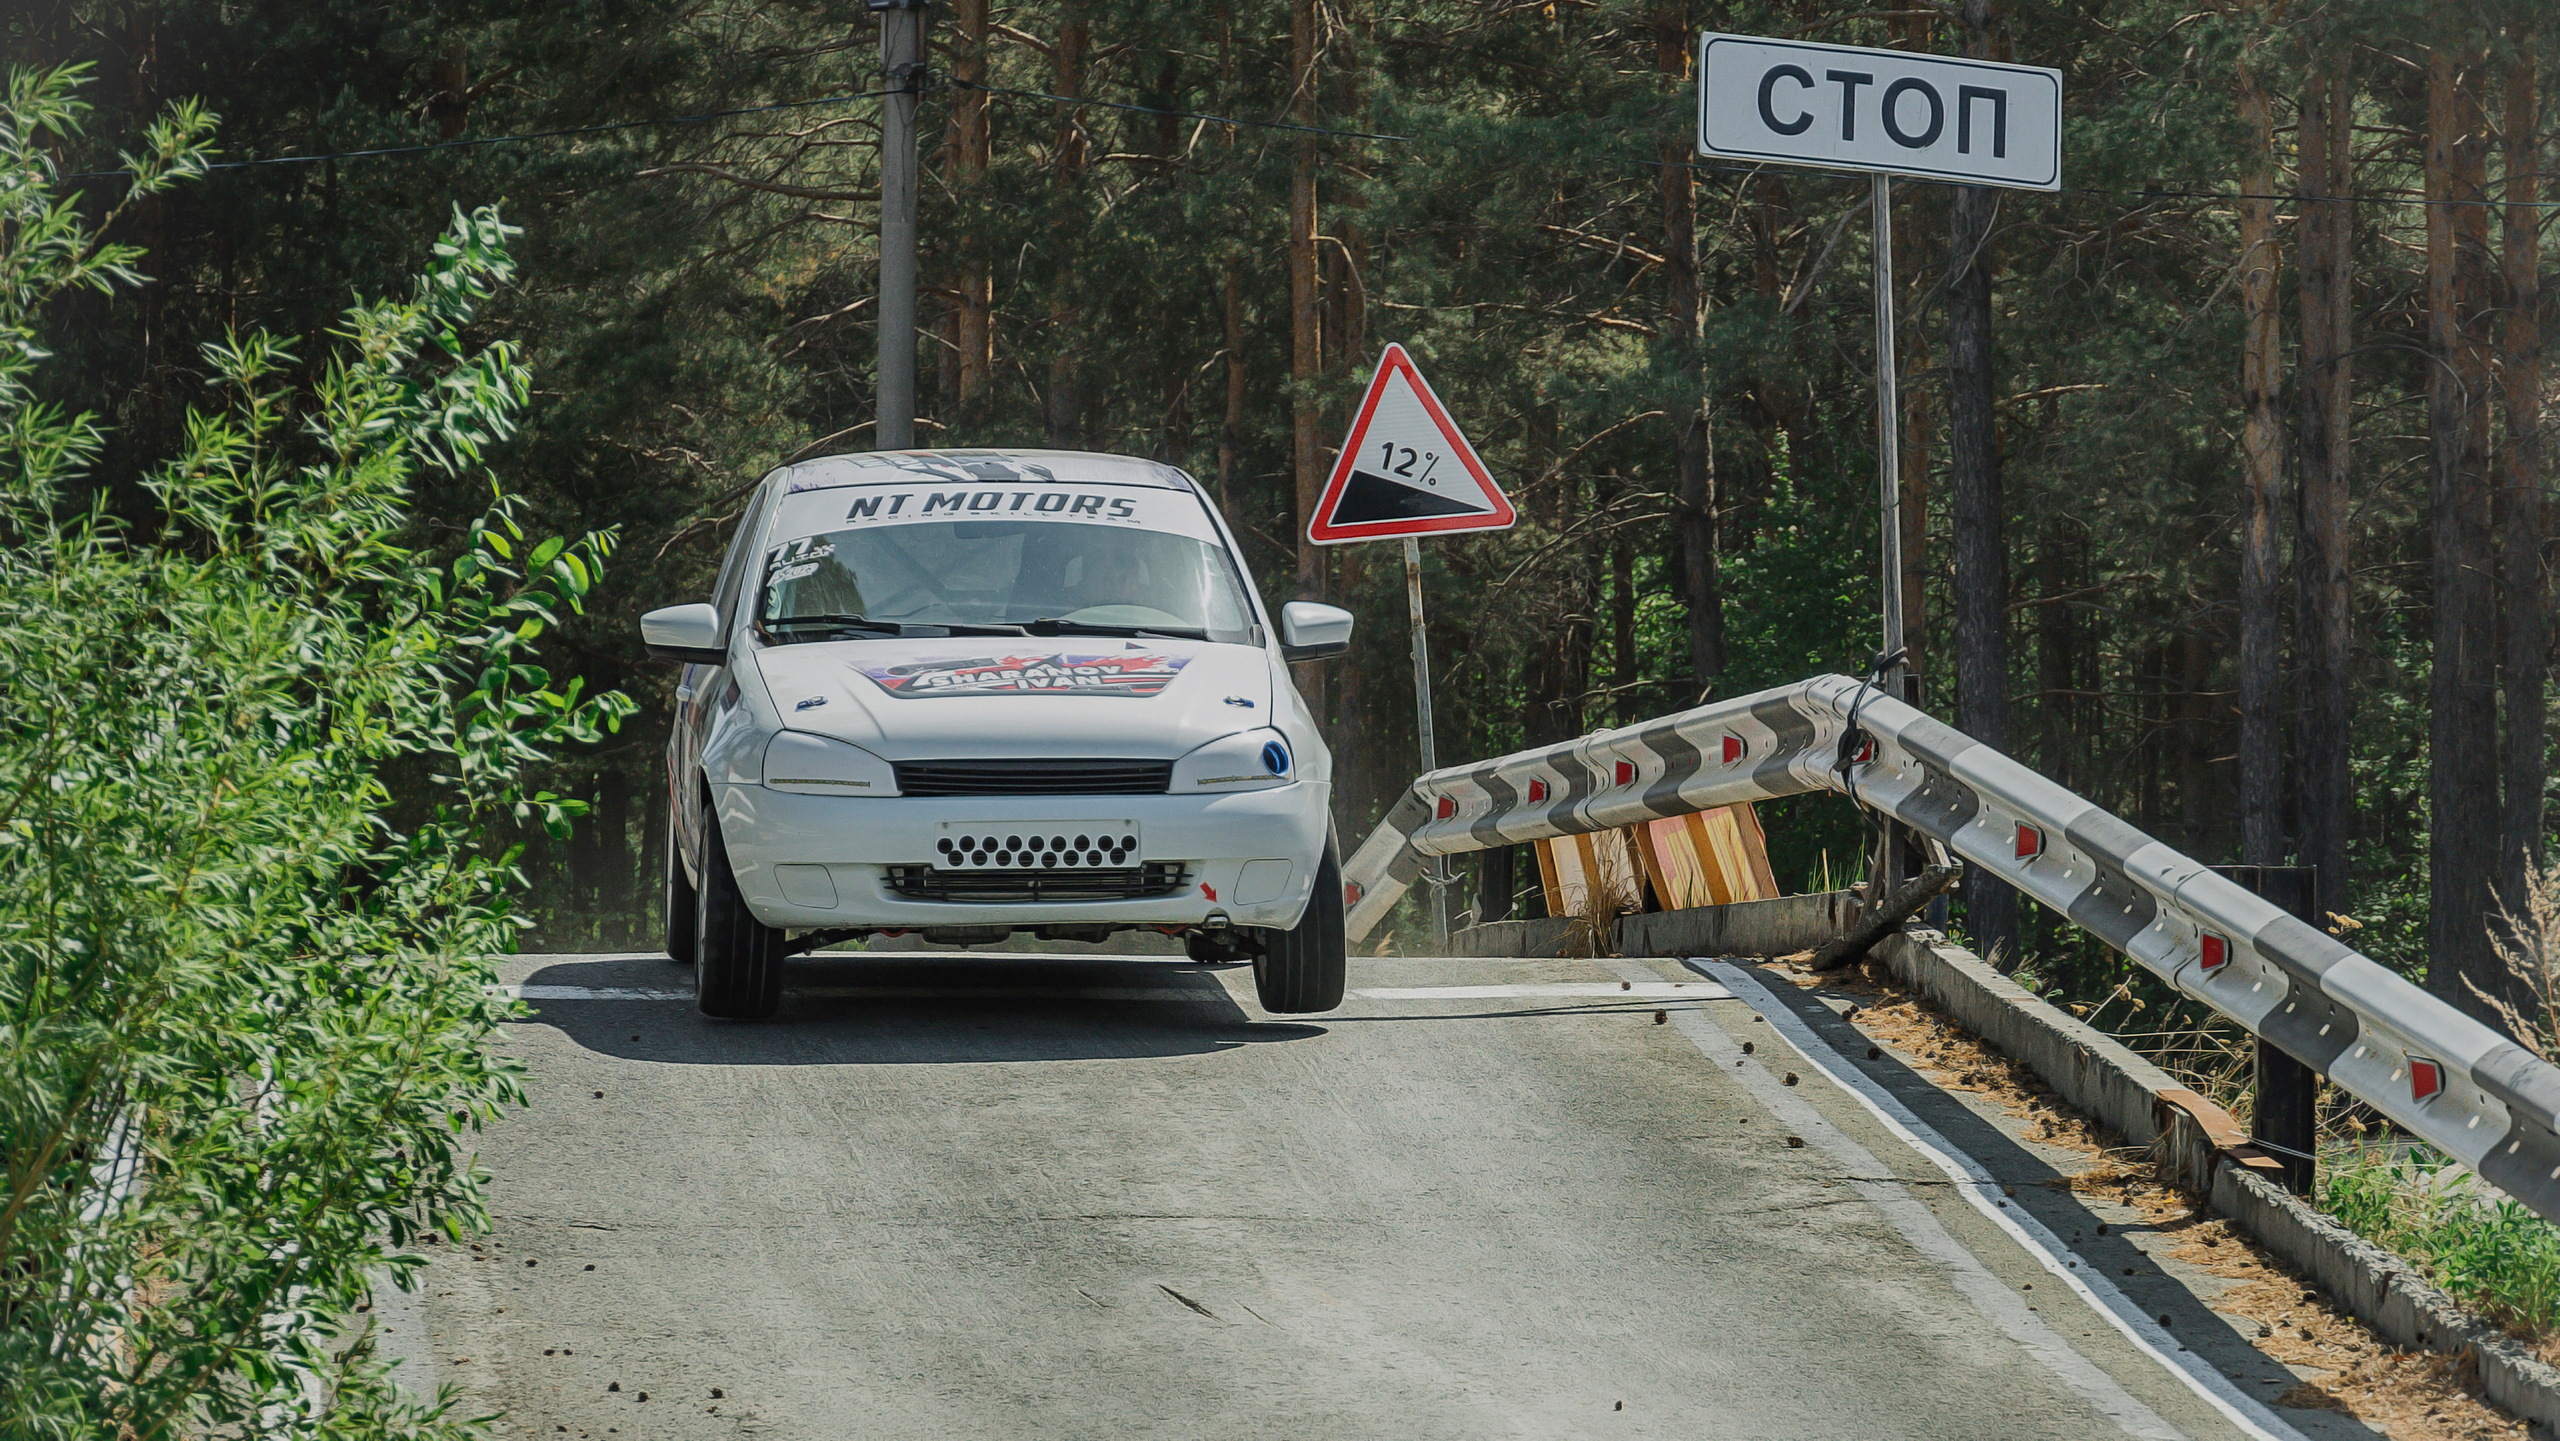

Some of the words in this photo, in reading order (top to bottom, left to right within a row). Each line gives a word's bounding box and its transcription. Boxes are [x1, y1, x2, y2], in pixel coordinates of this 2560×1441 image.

[1757, 63, 2008, 159] СТОП
[1381, 441, 1440, 487] 12%
[846, 493, 914, 520] NT
[921, 491, 1137, 518] MOTORS
[930, 663, 1122, 687] SHARANOV
[1016, 675, 1103, 690] IVAN
